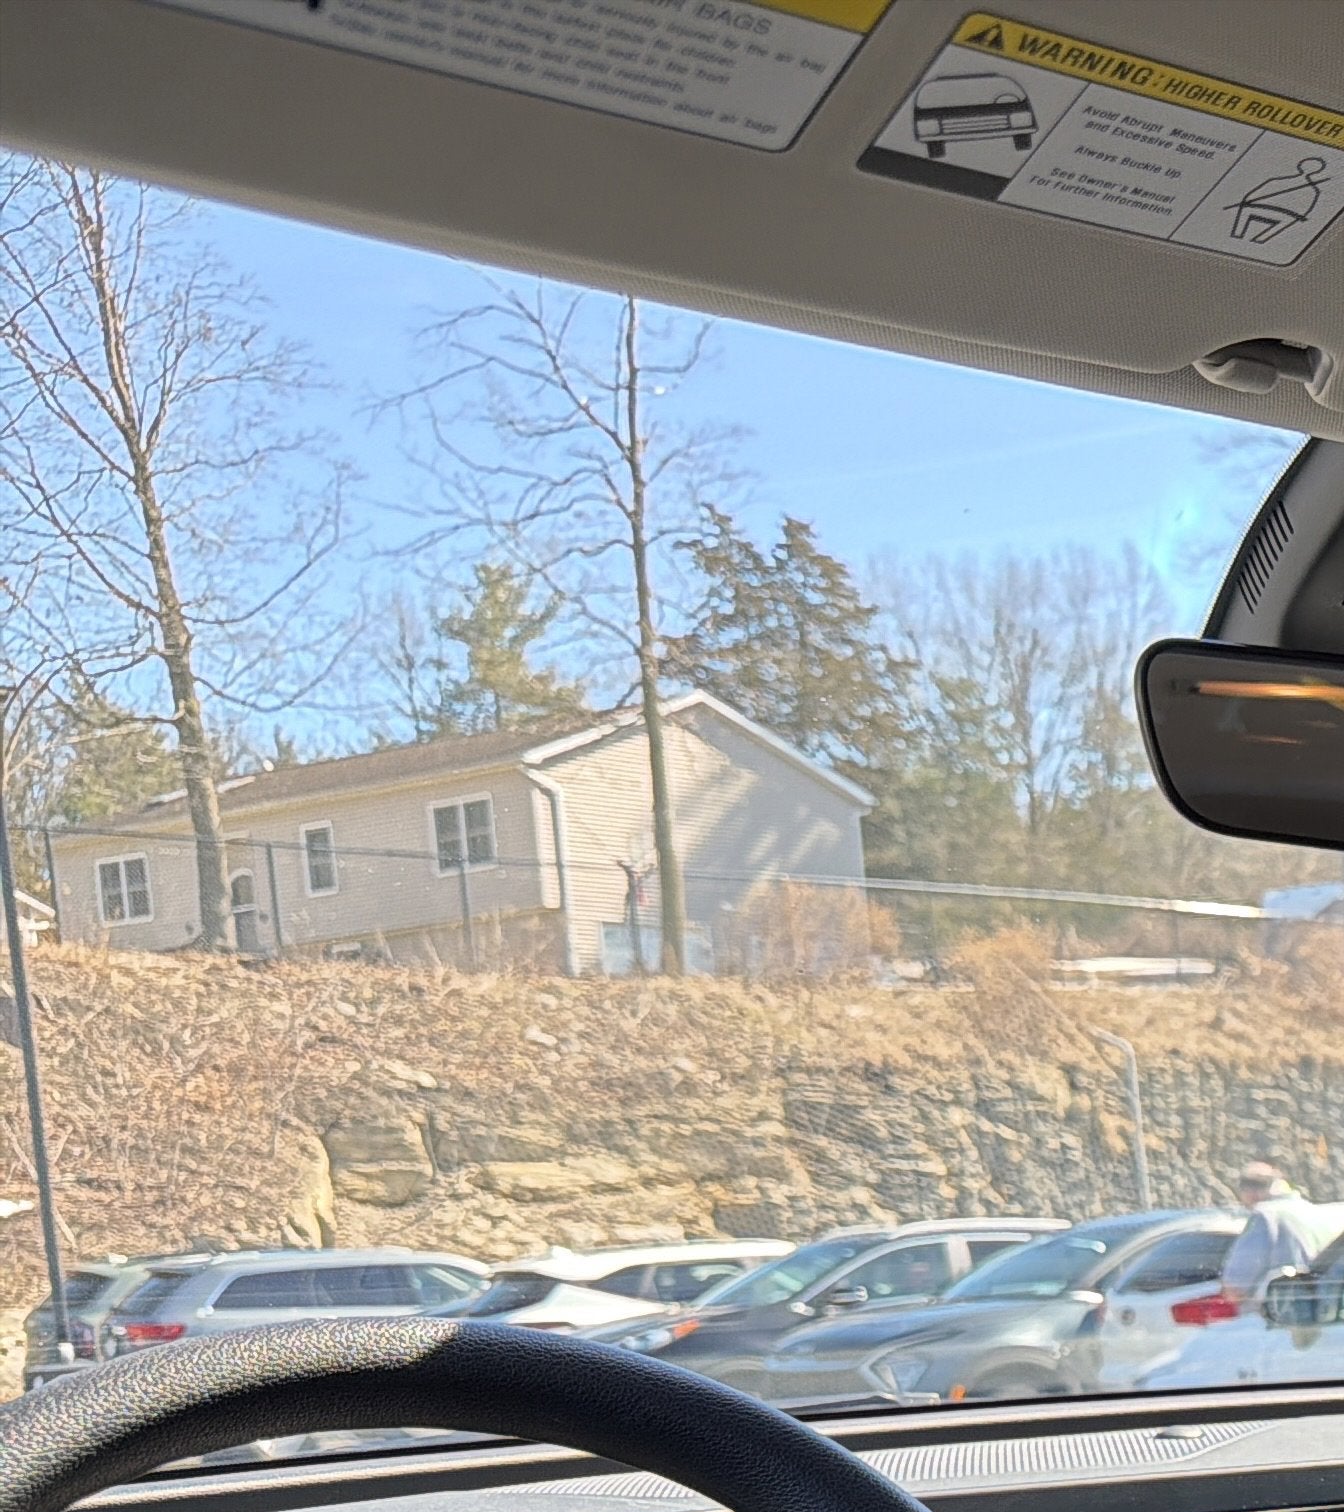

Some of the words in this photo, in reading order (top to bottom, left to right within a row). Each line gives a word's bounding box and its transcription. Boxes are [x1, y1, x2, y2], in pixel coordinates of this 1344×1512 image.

[695, 3, 773, 35] BAGS
[1163, 78, 1242, 110] HIGHER
[1243, 100, 1344, 138] ROLLOVER
[1083, 105, 1120, 121] Avoid
[1121, 115, 1164, 135] Abrupt
[1169, 127, 1238, 153] Maneuvers
[1085, 121, 1111, 134] and
[1112, 127, 1173, 149] Excessive
[1075, 144, 1118, 164] Always
[1121, 156, 1163, 174] Buckle
[1029, 175, 1051, 187] For
[1053, 181, 1100, 199] Further
[1050, 167, 1076, 181] See
[1130, 187, 1177, 205] Manual
